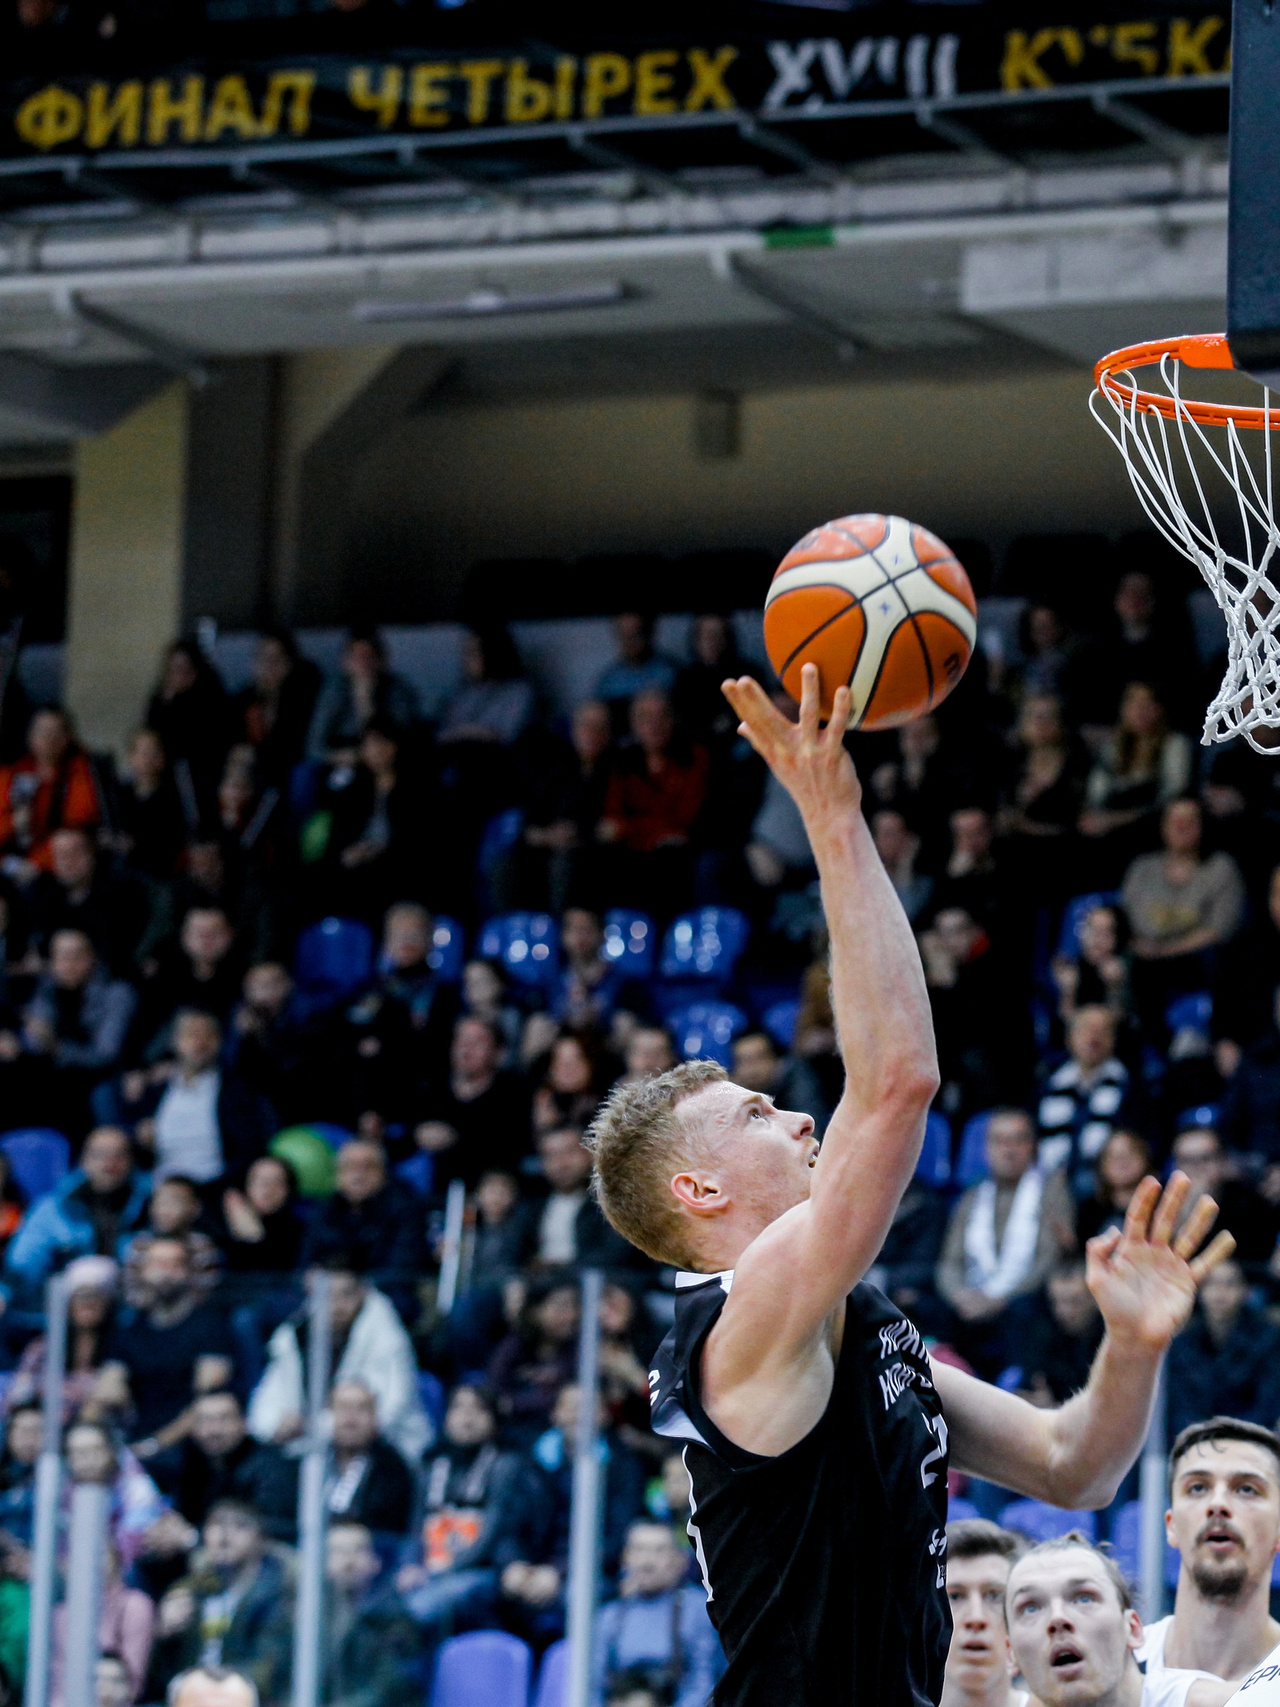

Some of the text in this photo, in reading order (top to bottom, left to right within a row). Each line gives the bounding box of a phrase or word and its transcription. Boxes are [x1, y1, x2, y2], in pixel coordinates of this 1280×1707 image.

[15, 69, 316, 151] ФИНАЛ
[348, 45, 739, 129] ЧЕТЫРЕХ
[1001, 15, 1233, 94] КУБК
